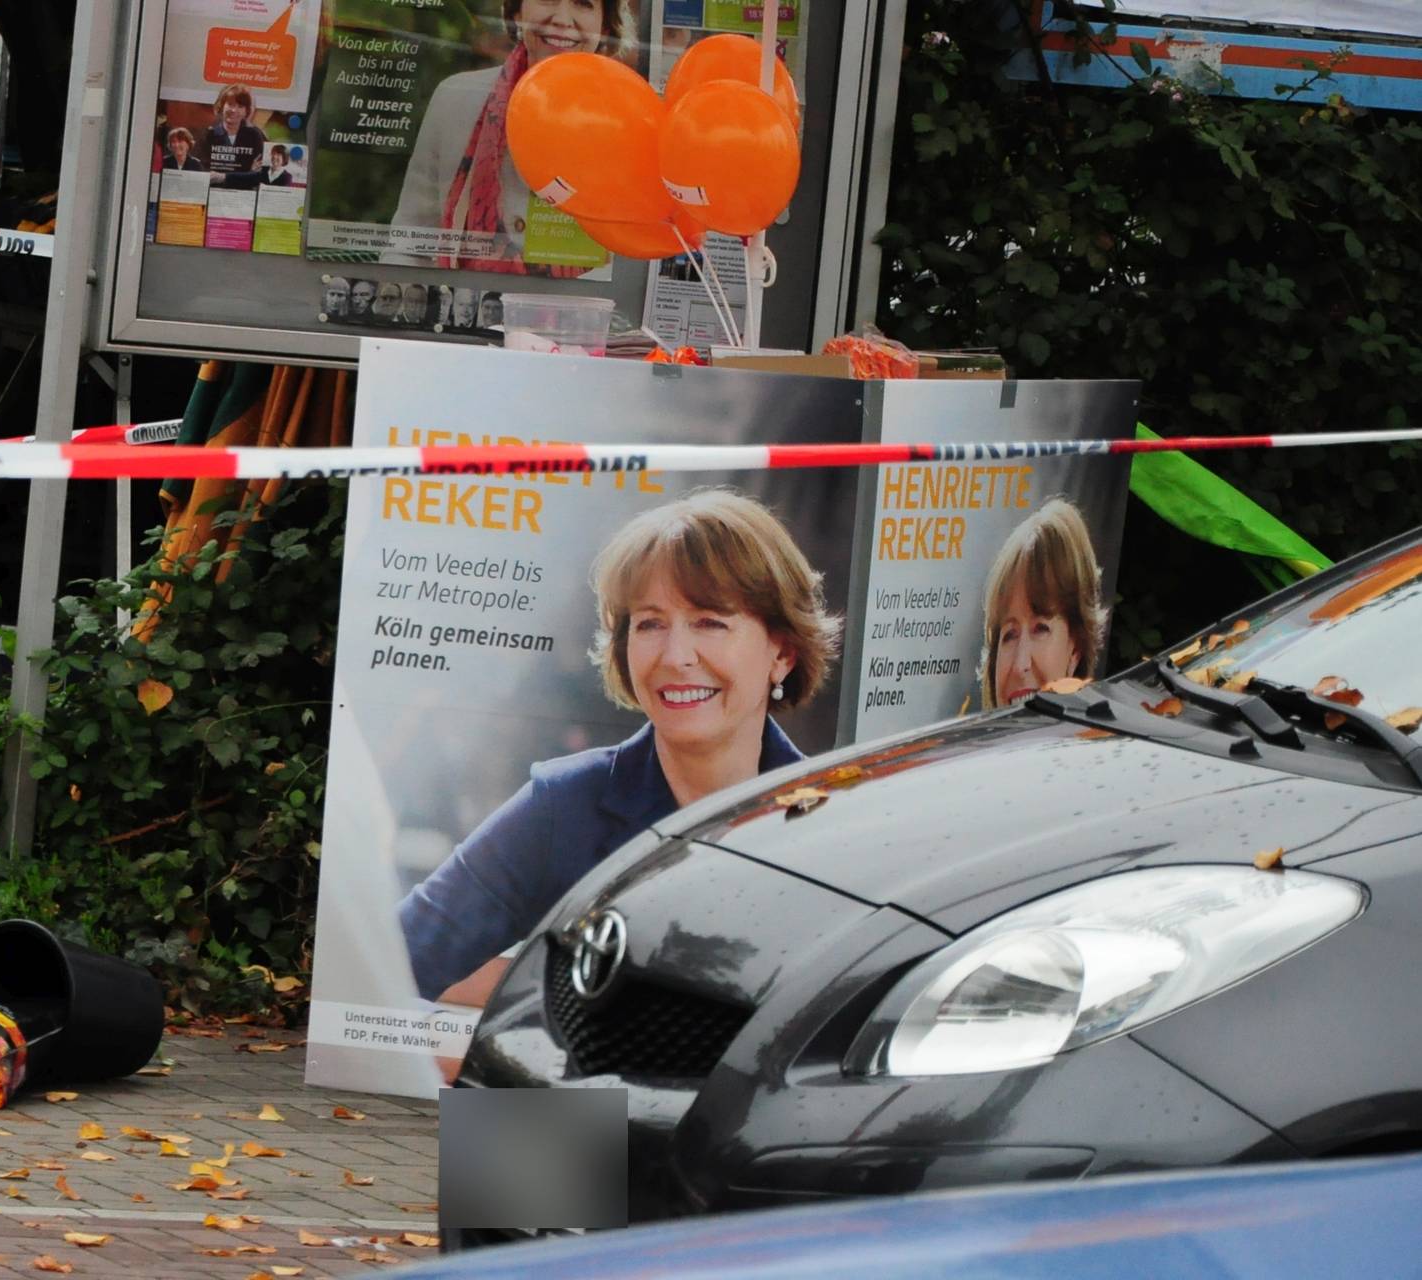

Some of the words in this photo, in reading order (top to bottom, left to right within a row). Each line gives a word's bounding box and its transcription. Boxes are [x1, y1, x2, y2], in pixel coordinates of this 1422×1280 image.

[338, 36, 363, 49] Von
[366, 38, 390, 51] der
[391, 40, 419, 55] Kita
[358, 55, 377, 69] bis
[380, 57, 393, 71] in
[396, 58, 417, 73] die
[336, 70, 415, 92] Ausbildung:
[350, 96, 363, 109] In
[367, 99, 413, 113] unsere
[357, 113, 411, 130] Zukunft
[211, 145, 254, 155] HENRIETTE
[330, 129, 407, 148] investieren.
[211, 153, 236, 162] REKER
[882, 465, 1034, 510] HENRIETTE
[382, 478, 544, 533] REKER
[878, 516, 967, 561] REKER
[381, 547, 427, 574] Vom
[435, 552, 507, 583] Veedel
[512, 558, 544, 585] bis
[377, 581, 414, 601] zur
[418, 580, 537, 613] Metropole:
[875, 589, 901, 610] Vom
[903, 587, 941, 610] Veedel
[943, 588, 961, 609] bis
[374, 614, 424, 642] Köln
[429, 619, 555, 653] gemeinsam
[872, 621, 890, 639] zur
[892, 617, 955, 642] Metropole:
[370, 644, 452, 672] planen.
[868, 656, 894, 678] Köln
[896, 654, 961, 681] gemeinsam
[865, 687, 906, 712] planen.
[345, 1011, 408, 1029] Unterstützt
[411, 1020, 431, 1031] von
[344, 1028, 368, 1042] FDP,
[371, 1032, 398, 1045] Freie
[401, 1034, 441, 1049] Wähler
